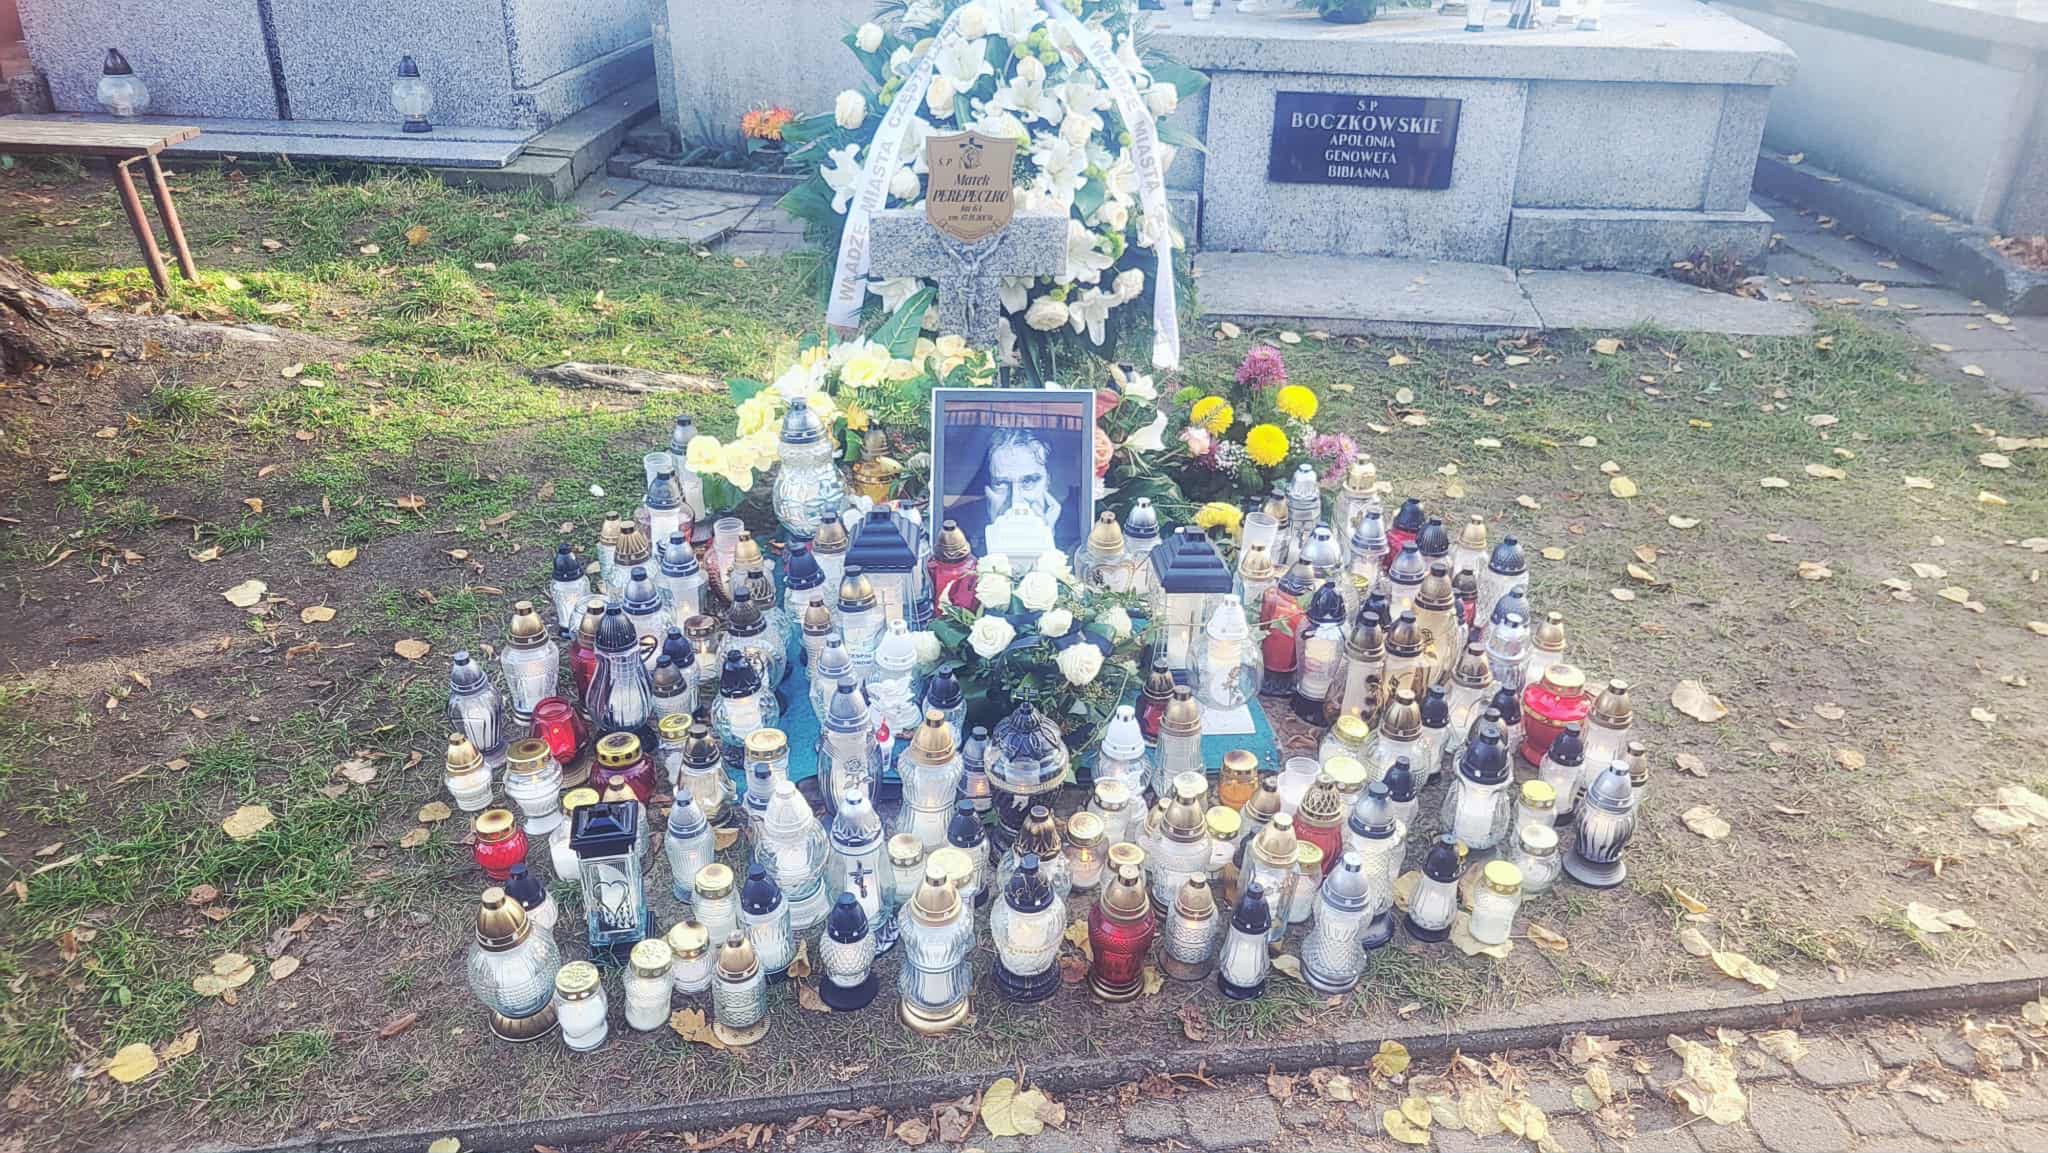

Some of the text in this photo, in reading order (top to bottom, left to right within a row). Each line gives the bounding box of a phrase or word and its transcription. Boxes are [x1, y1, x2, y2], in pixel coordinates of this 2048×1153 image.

[1291, 112, 1443, 134] BOCZKOWSKIE
[1329, 133, 1396, 148] APOLONIA
[1133, 120, 1161, 193] MIASTA
[1325, 149, 1397, 164] GENOWEFA
[860, 141, 893, 215] MIASTA
[1327, 164, 1391, 180] BIBIANNA
[954, 174, 991, 187] Marek
[932, 189, 1009, 203] PEREPECZKO
